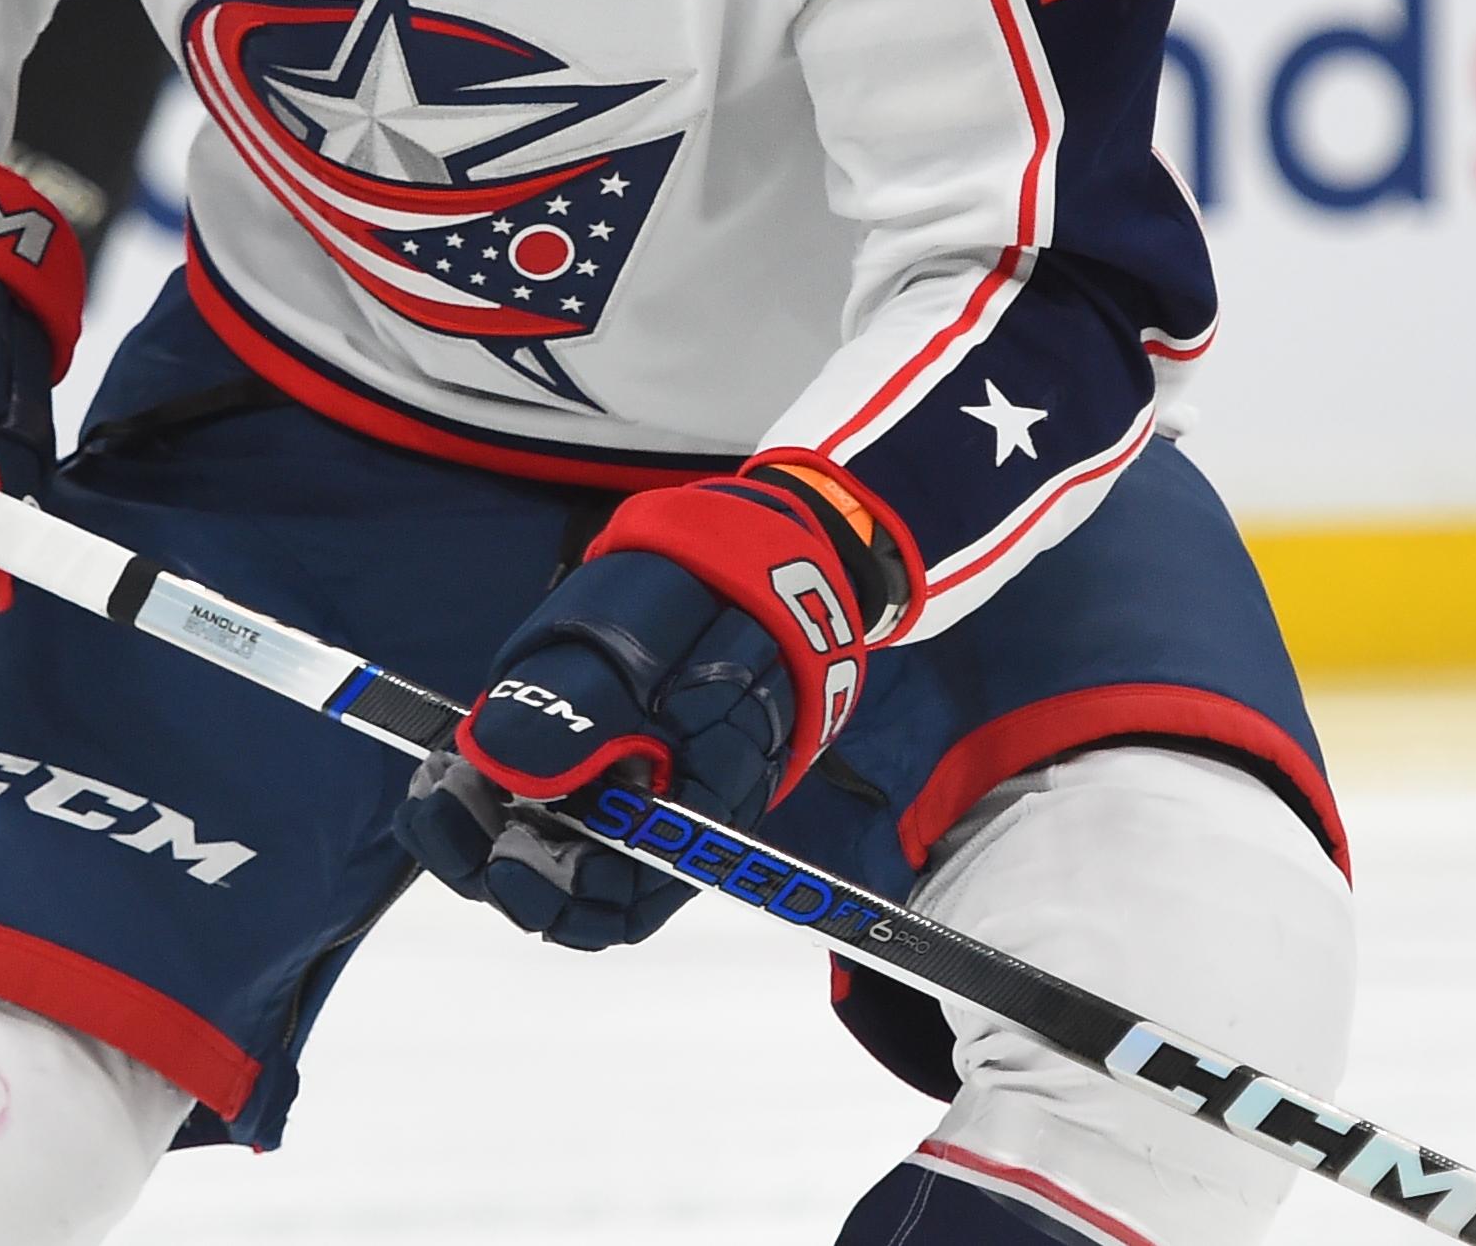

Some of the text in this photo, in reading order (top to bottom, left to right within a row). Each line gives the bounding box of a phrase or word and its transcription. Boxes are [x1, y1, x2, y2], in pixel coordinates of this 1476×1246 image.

[190, 604, 261, 644] NANOLITE
[768, 557, 857, 772] CC
[488, 680, 595, 733] CCM
